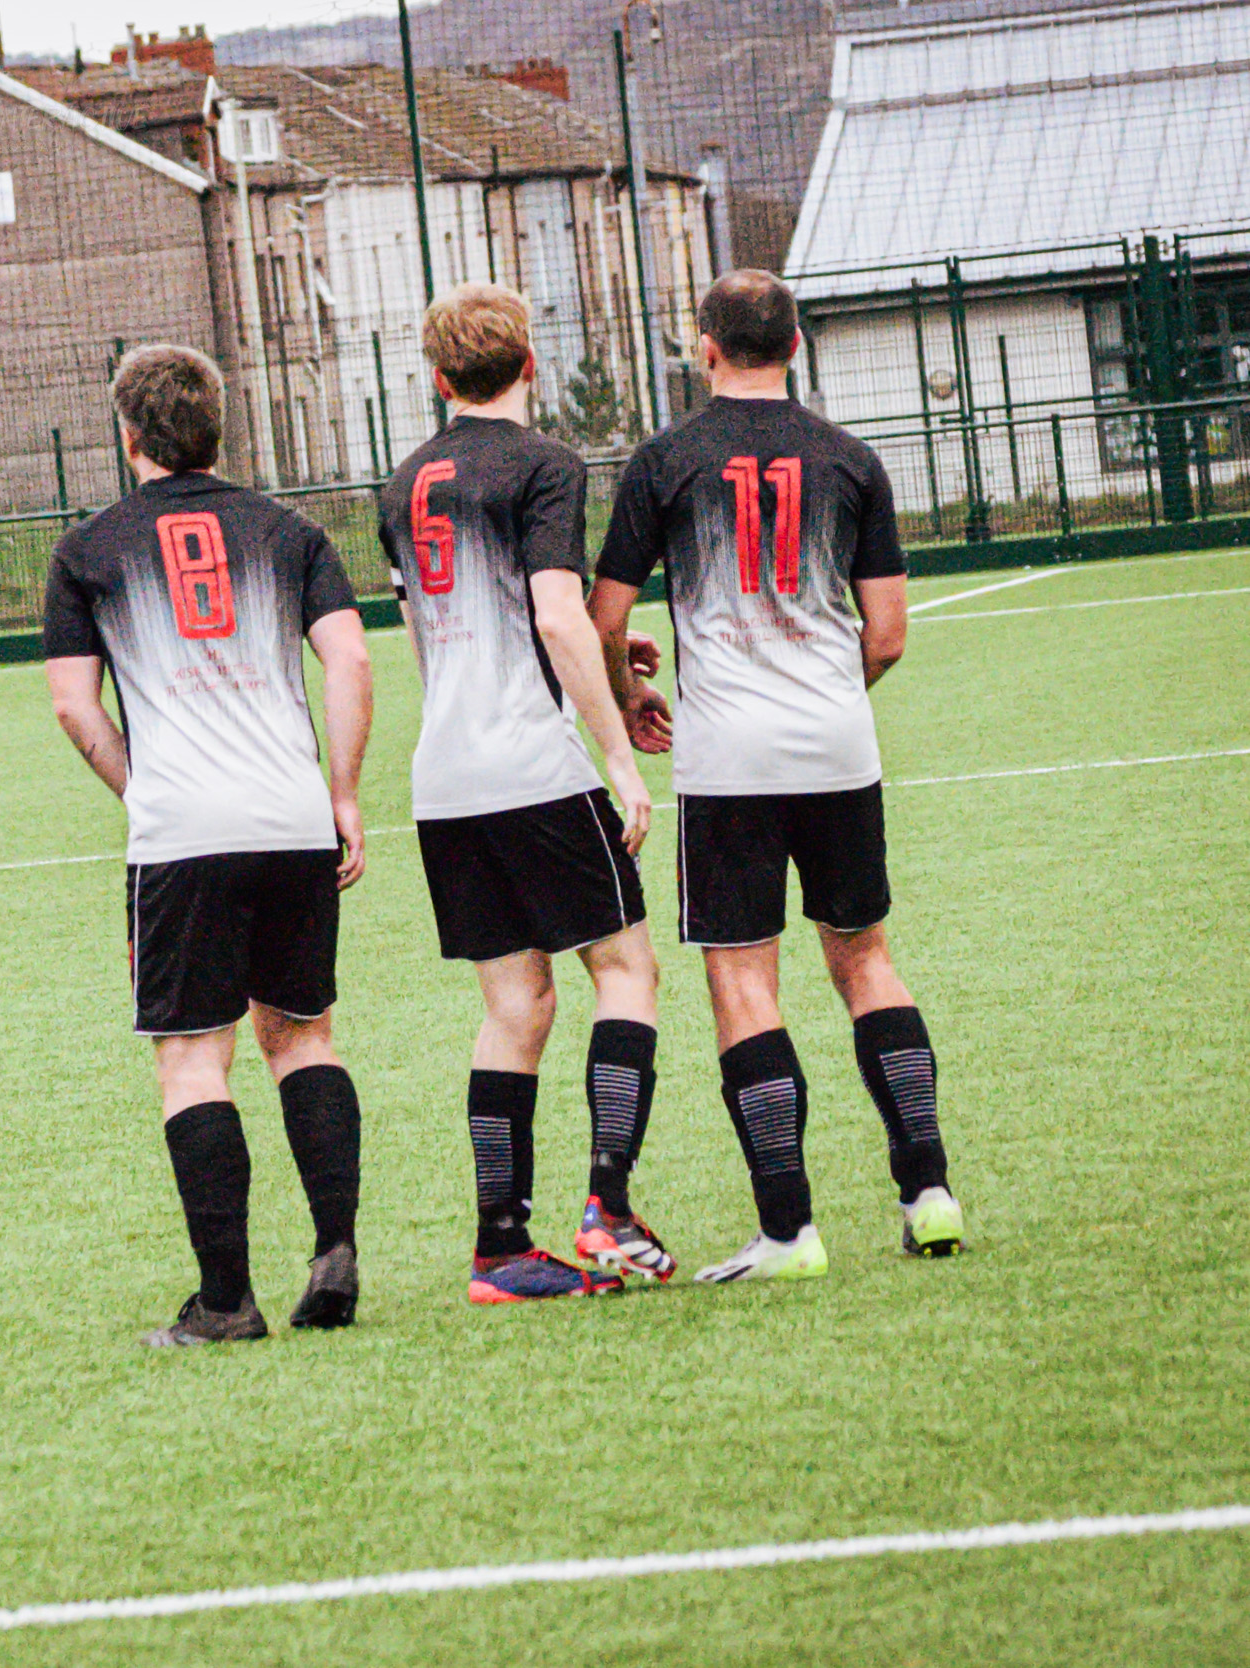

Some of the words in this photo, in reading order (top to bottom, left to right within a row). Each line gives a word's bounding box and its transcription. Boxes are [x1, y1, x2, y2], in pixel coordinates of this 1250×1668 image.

[155, 511, 236, 640] 8
[410, 459, 456, 596] 6
[722, 456, 802, 594] 11
